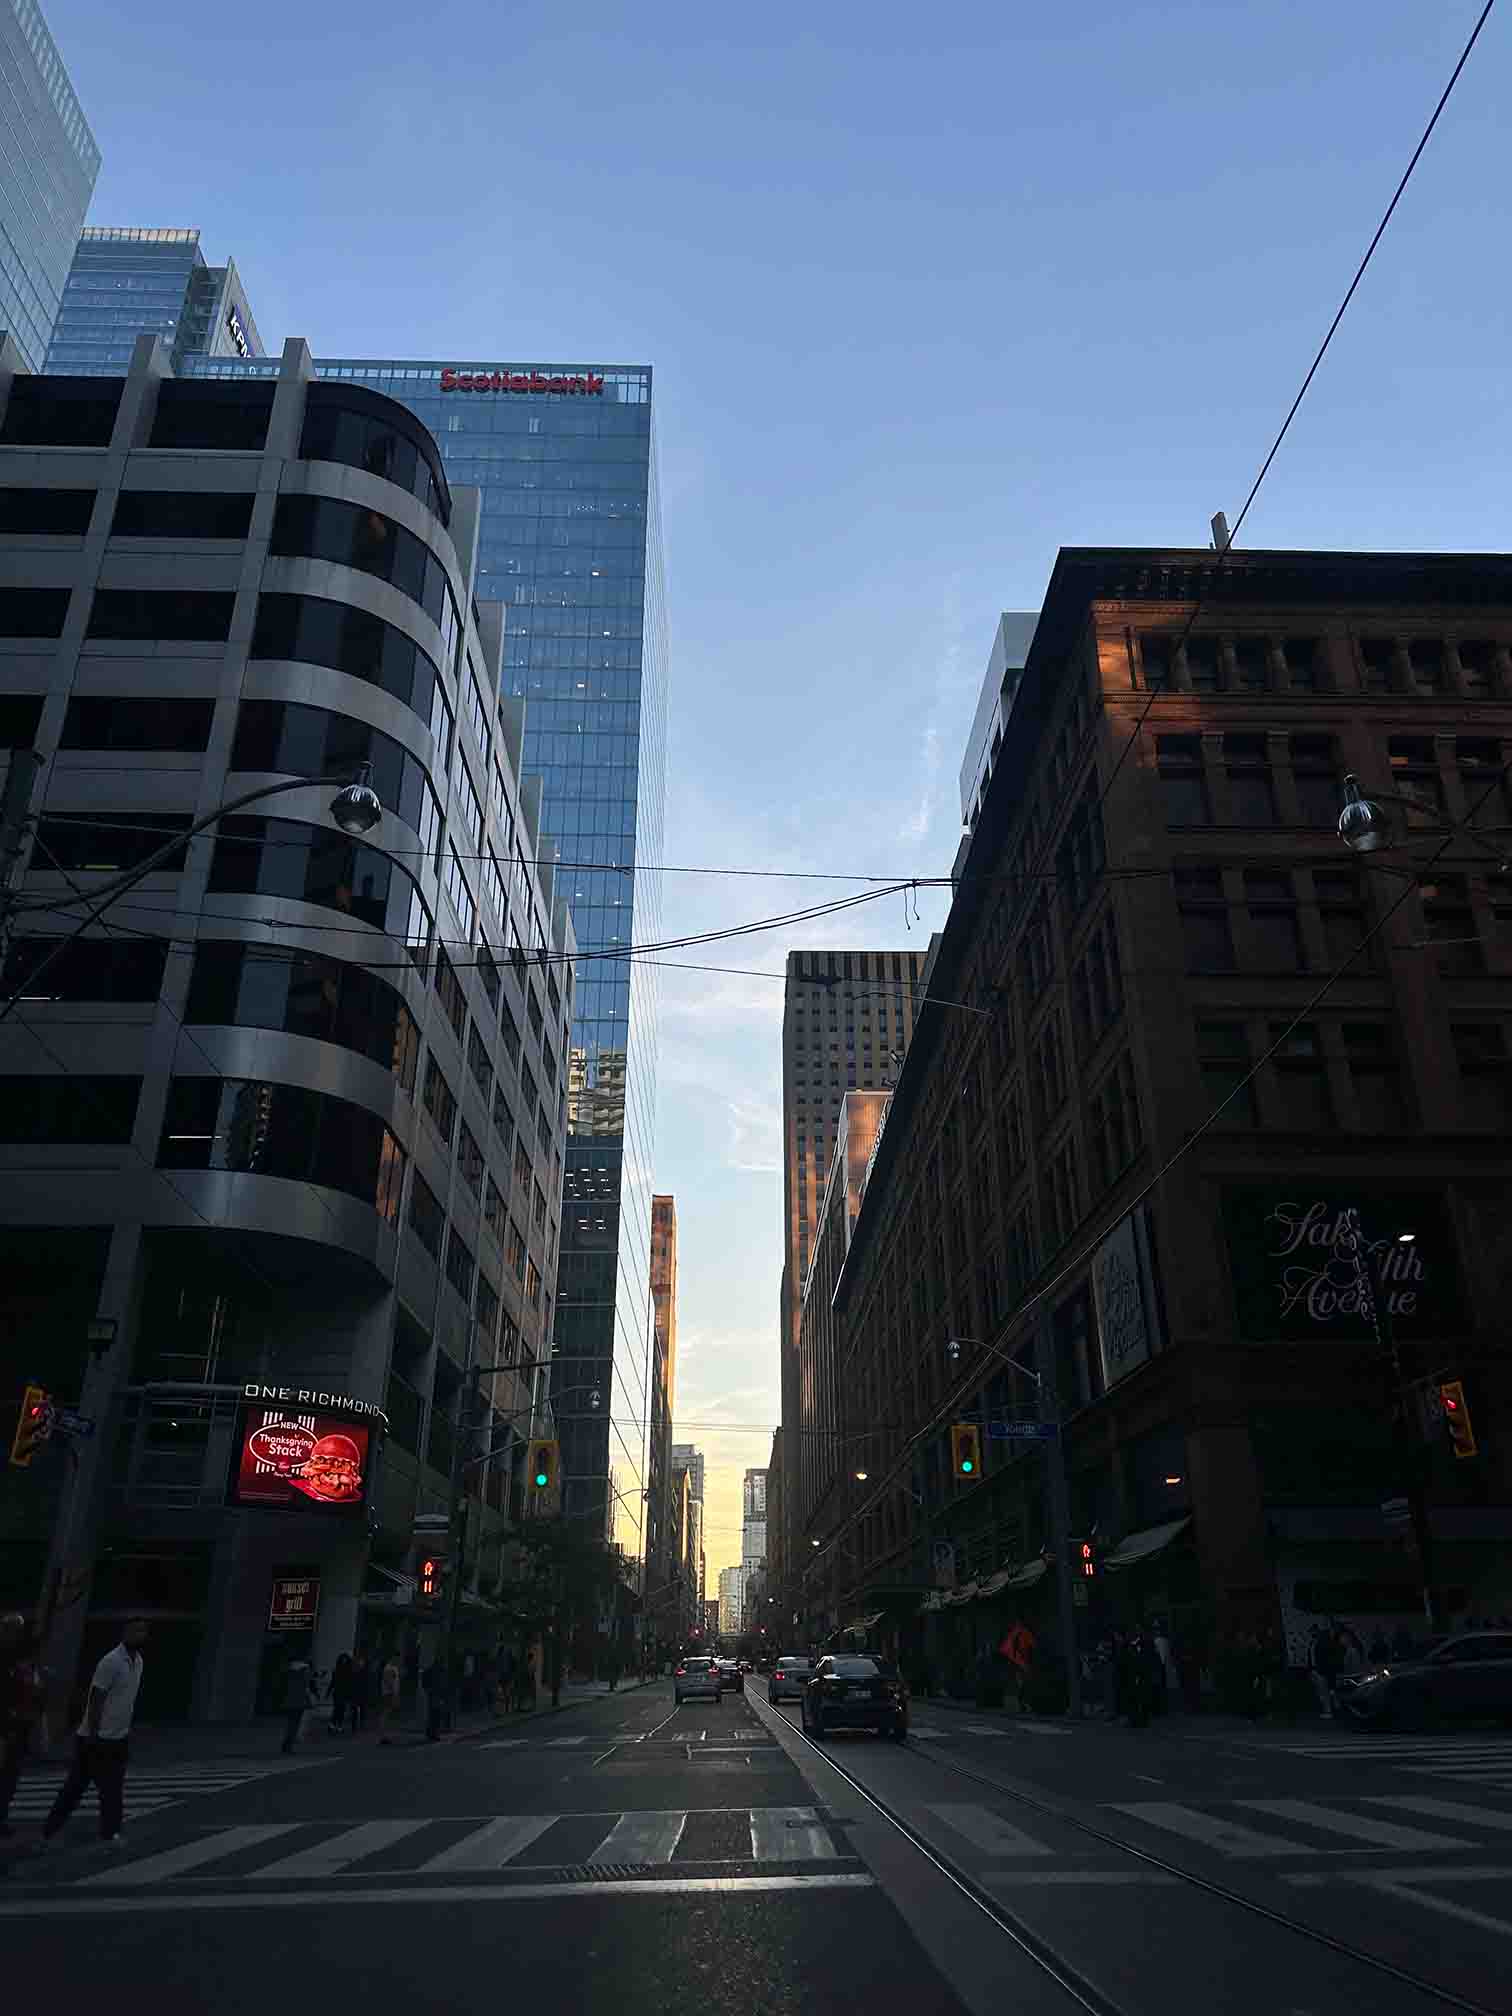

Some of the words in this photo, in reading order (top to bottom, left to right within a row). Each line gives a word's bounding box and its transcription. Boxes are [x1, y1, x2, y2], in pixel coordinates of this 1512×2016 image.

[440, 368, 604, 396] Scotiabank
[1264, 1200, 1362, 1257] Sak
[1272, 1263, 1417, 1320] Avee
[244, 1384, 291, 1400] ONE
[298, 1389, 381, 1417] RICHMOND
[280, 1421, 299, 1431] NEW
[259, 1433, 314, 1449] Thanksgiving
[268, 1443, 303, 1457] Stack
